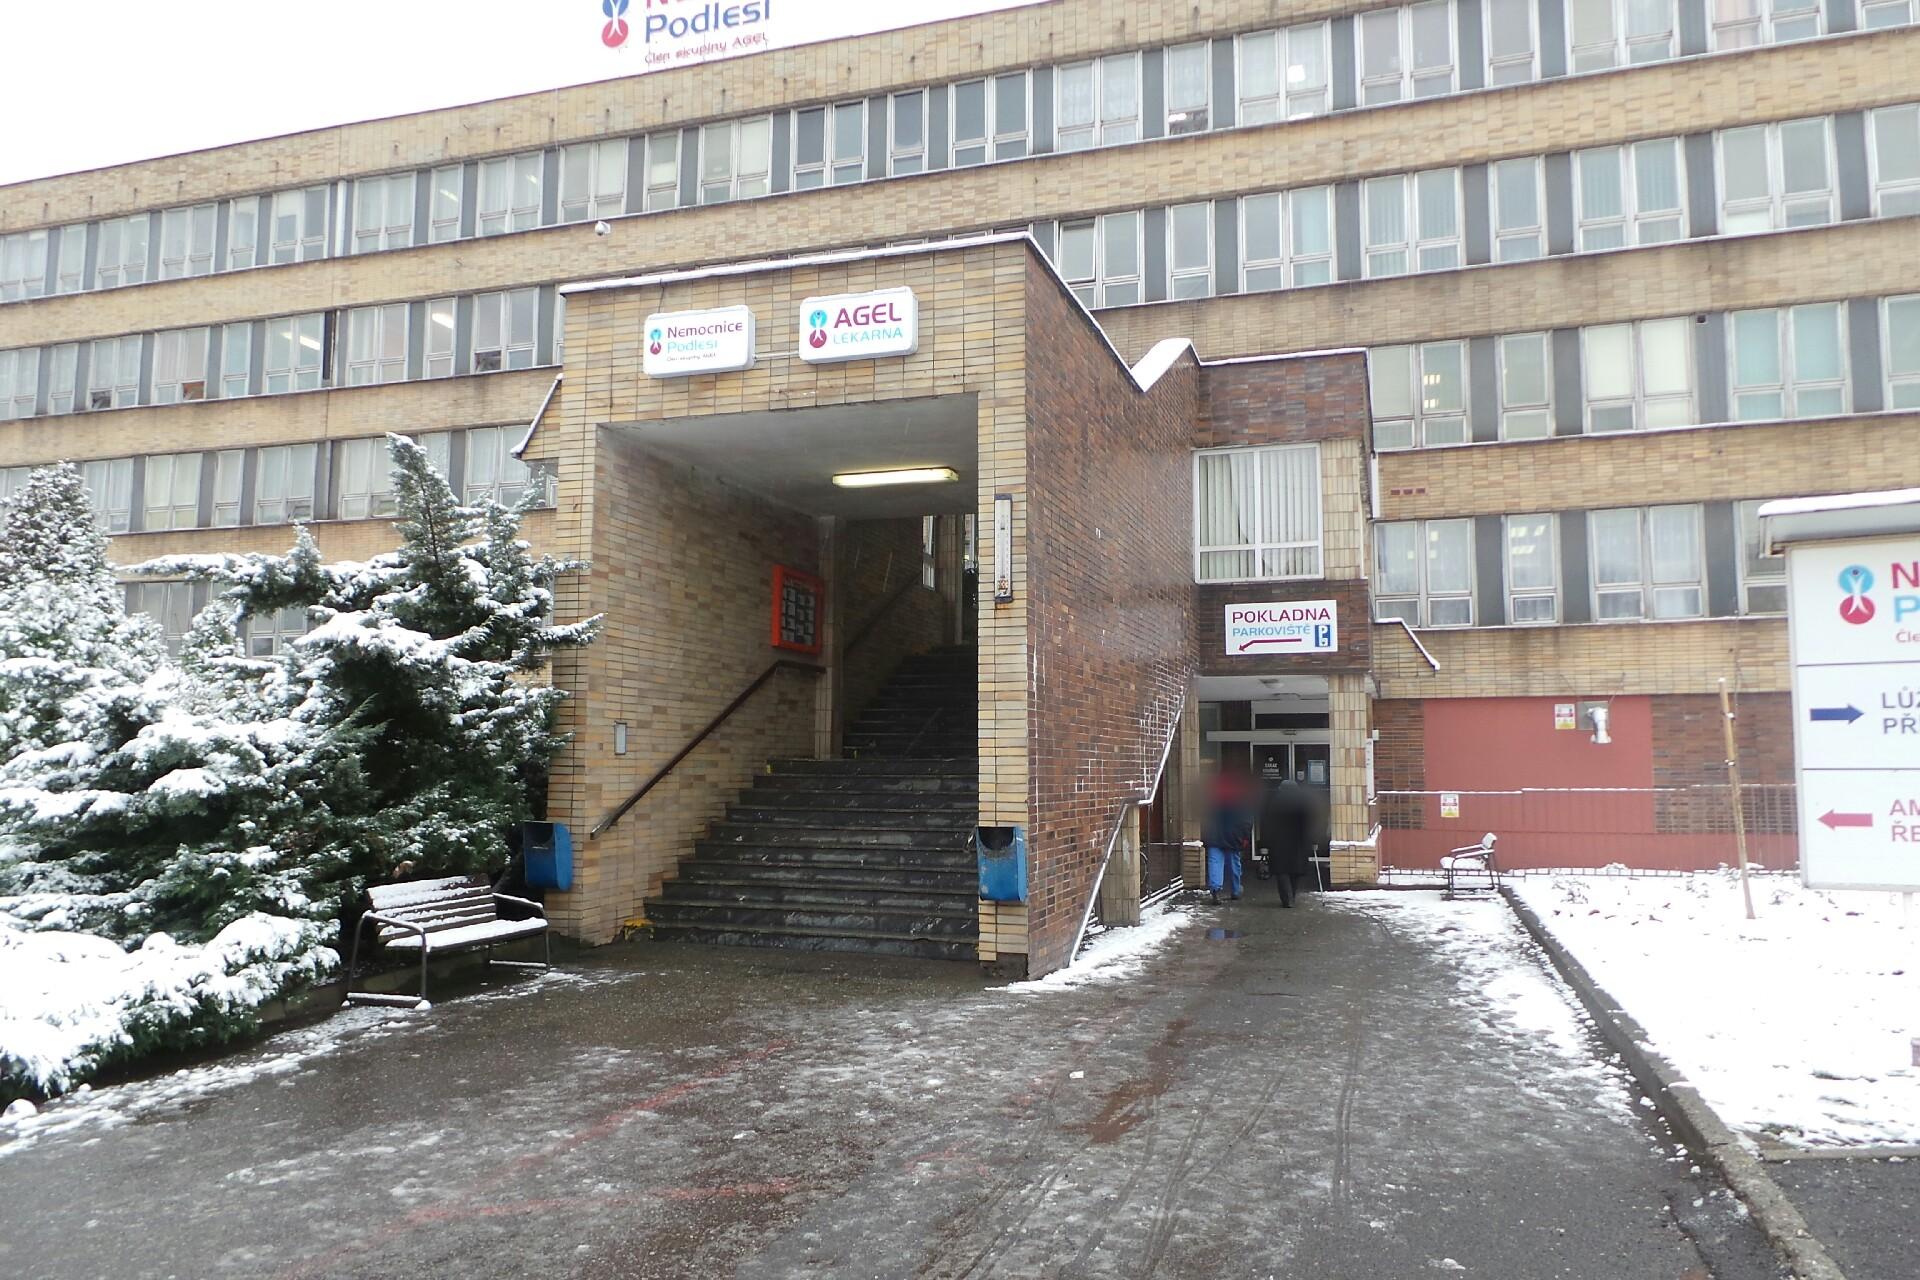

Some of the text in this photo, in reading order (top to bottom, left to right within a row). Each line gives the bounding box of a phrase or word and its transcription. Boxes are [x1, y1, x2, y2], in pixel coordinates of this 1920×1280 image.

[833, 302, 902, 328] AGEL
[667, 320, 743, 339] Nemocnice
[1232, 607, 1331, 623] POKLADNA
